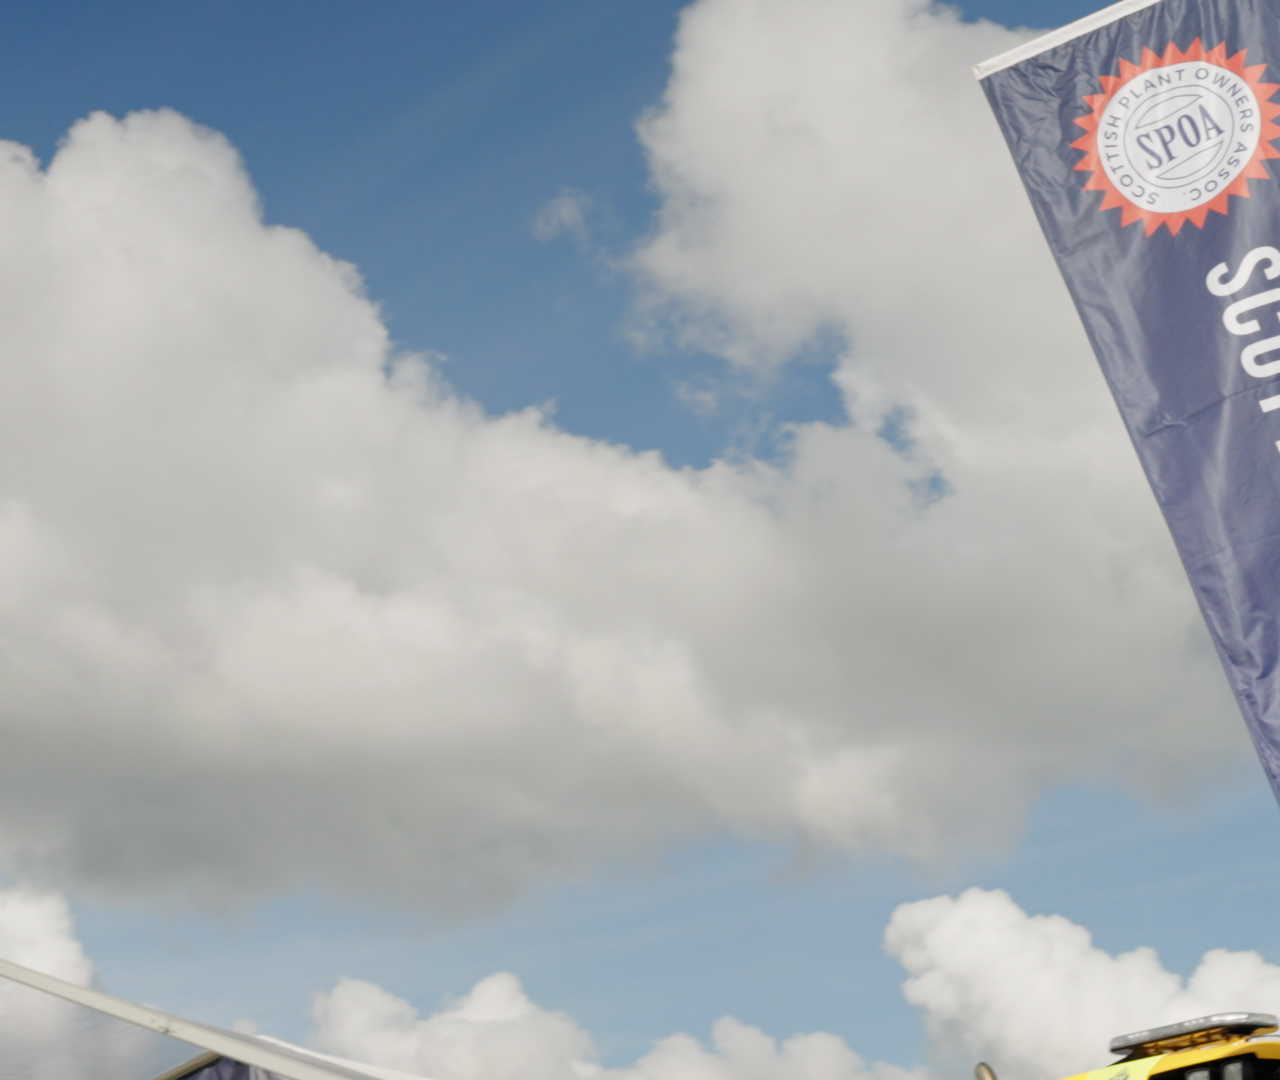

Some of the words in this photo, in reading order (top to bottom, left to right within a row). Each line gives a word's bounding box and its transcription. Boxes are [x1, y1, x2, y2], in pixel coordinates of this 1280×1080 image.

[1120, 68, 1187, 111] PLANT
[1195, 67, 1255, 135] OWNERS
[1103, 114, 1161, 206] SCOTTISH
[1135, 104, 1225, 172] SPOA
[1182, 142, 1249, 203] ASSOC.
